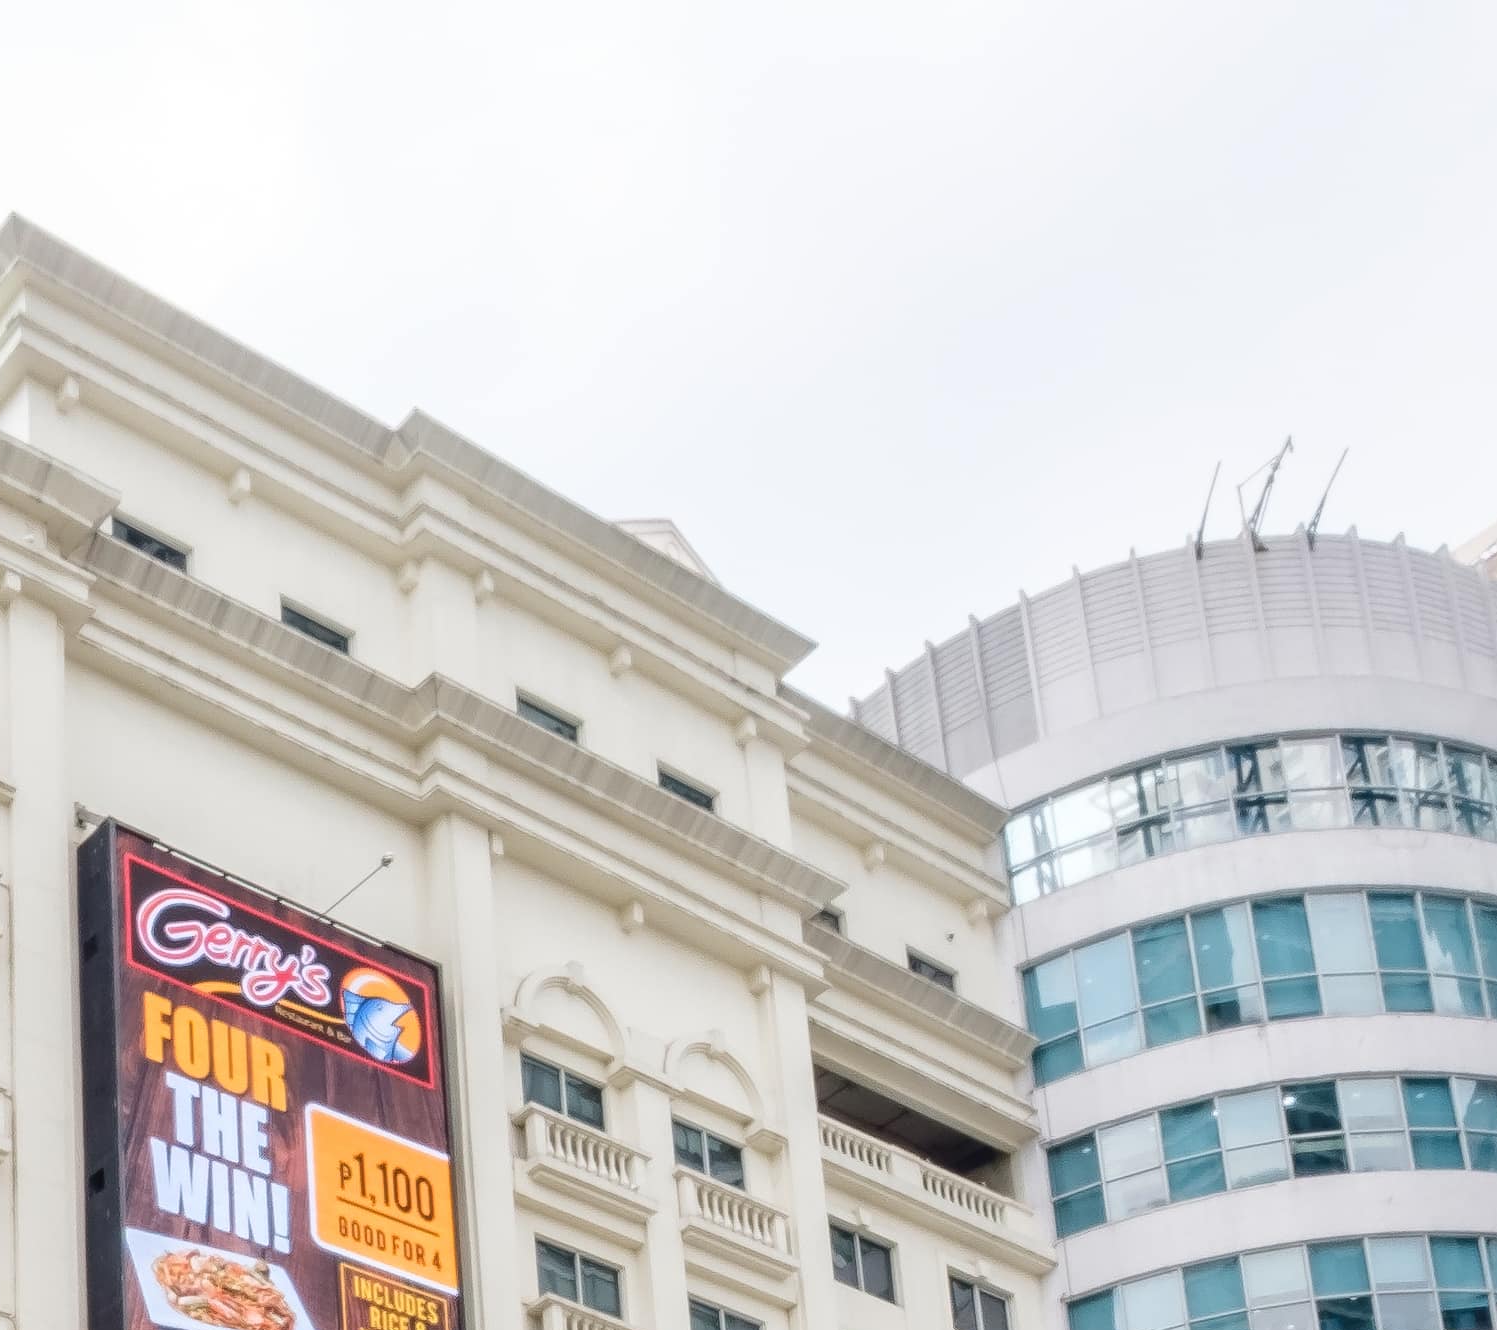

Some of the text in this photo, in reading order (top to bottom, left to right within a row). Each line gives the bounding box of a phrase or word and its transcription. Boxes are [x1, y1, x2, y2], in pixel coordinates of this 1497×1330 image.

[136, 889, 331, 1006] Gerry's
[144, 991, 287, 1112] FOUR
[165, 1071, 271, 1175] THE
[150, 1136, 291, 1255] WIN!
[339, 1216, 442, 1271] GOOD FOR 4
[353, 1275, 439, 1324] INCLUDES
